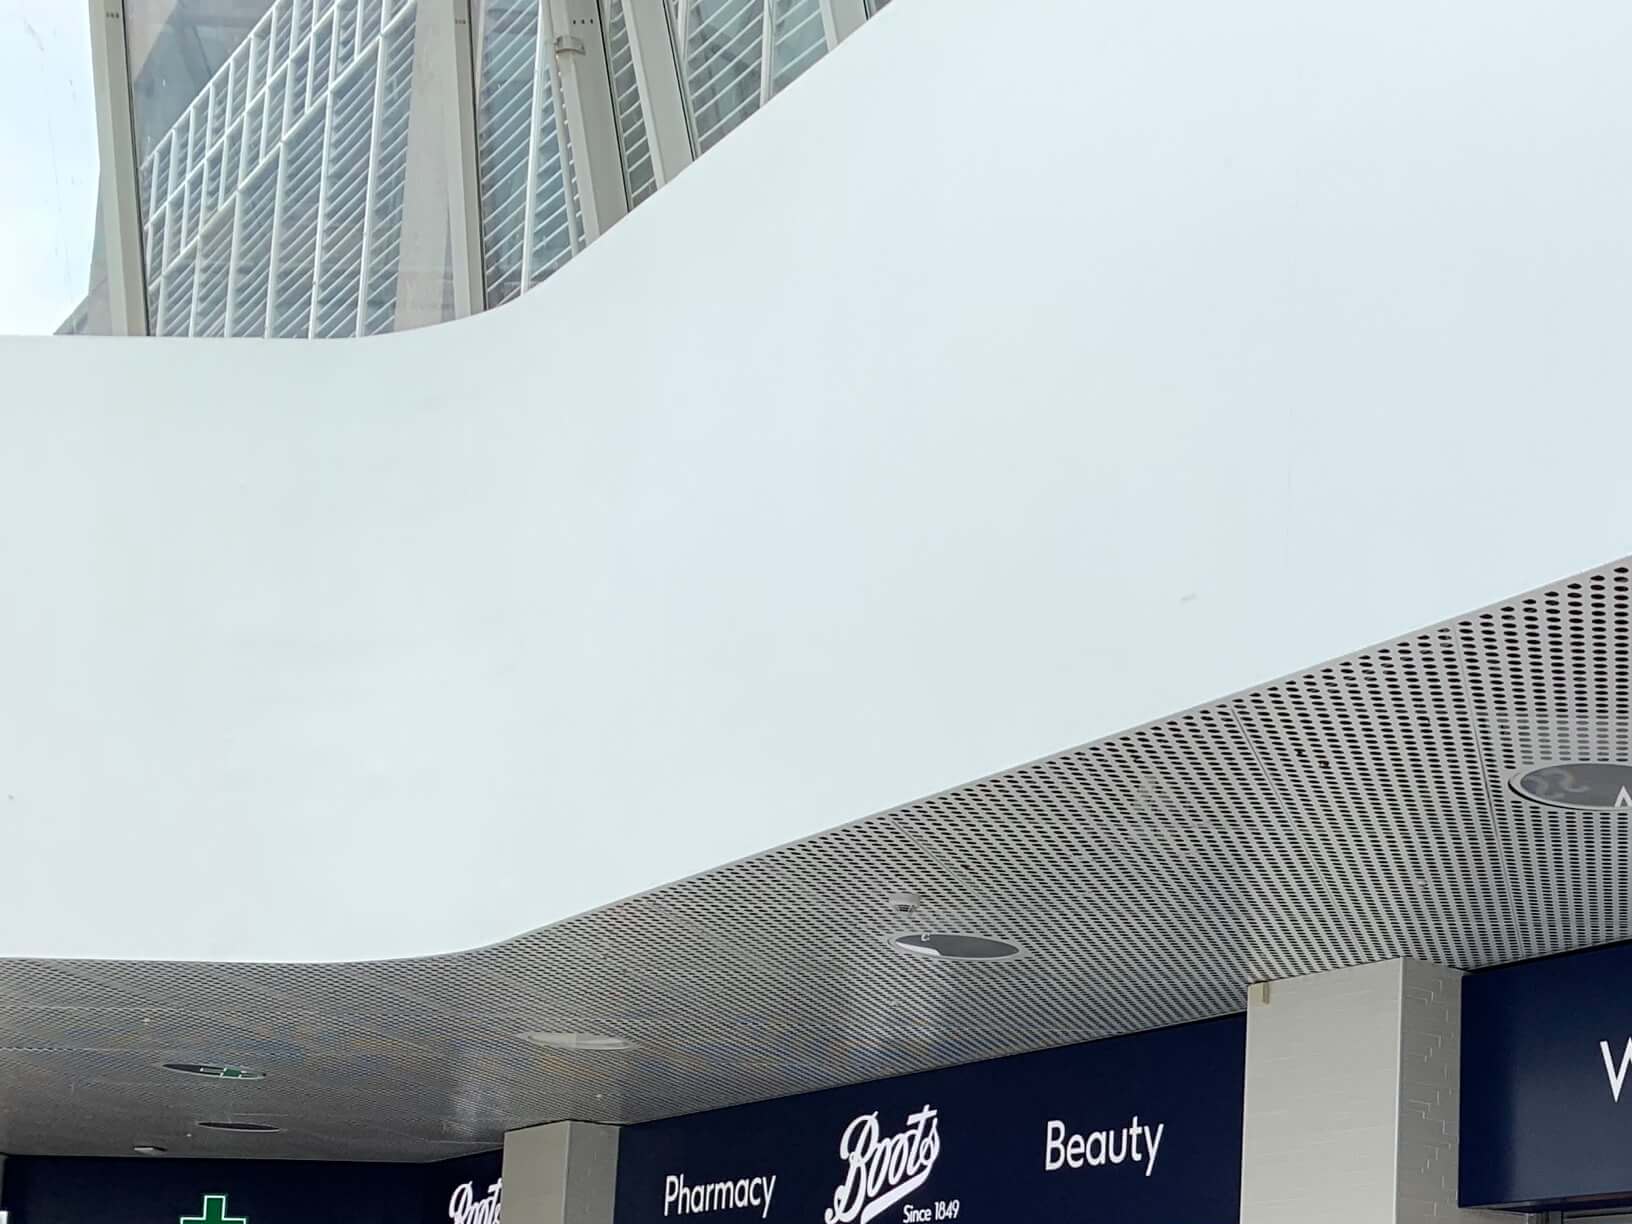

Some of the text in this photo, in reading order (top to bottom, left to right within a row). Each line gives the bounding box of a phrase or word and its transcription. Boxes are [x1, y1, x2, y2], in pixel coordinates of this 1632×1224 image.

[1045, 1116, 1164, 1177] Beauty
[664, 1174, 776, 1218] Pharmacy
[903, 1200, 959, 1224] Since 1849
